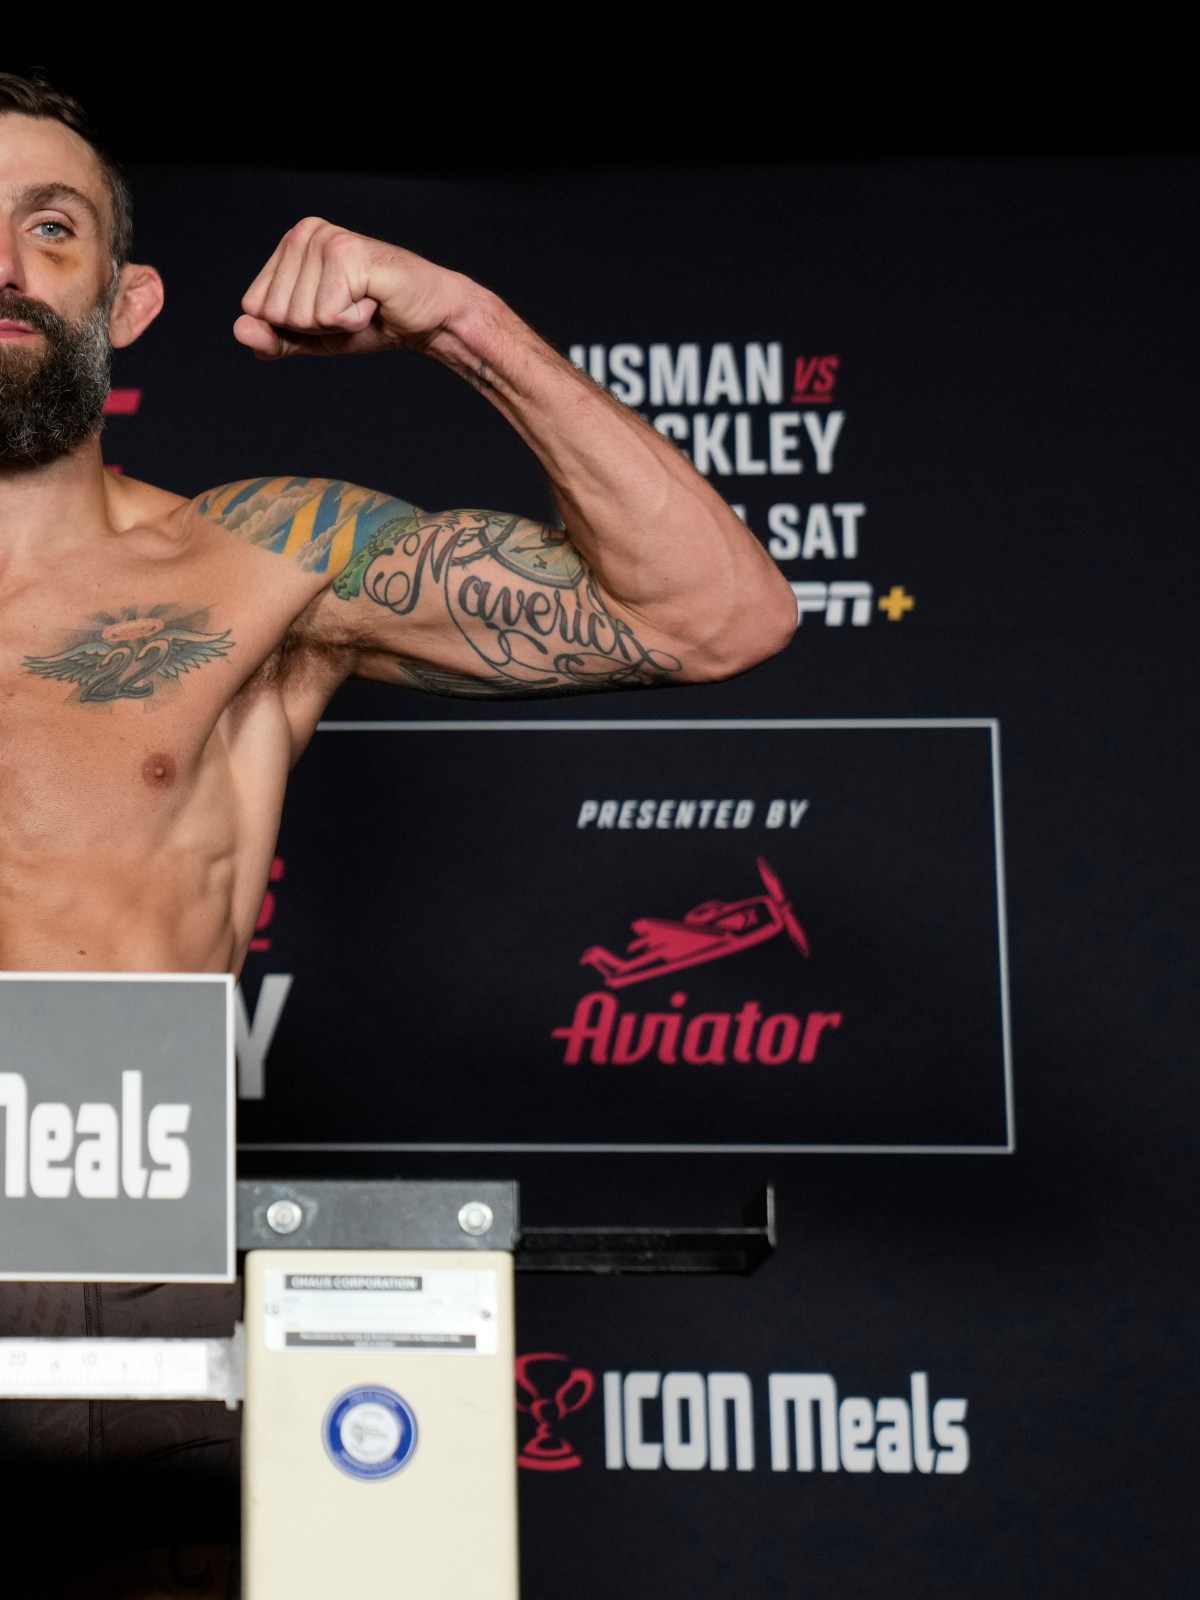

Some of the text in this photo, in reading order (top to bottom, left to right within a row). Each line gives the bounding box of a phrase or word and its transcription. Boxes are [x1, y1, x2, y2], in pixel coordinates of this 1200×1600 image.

[792, 356, 839, 395] VS
[768, 503, 866, 561] SAT
[363, 525, 656, 671] Maverick
[80, 639, 170, 702] 22
[577, 800, 809, 829] PRESENTED BY
[551, 991, 842, 1065] Aviator
[603, 1371, 970, 1474] ICON Meals
